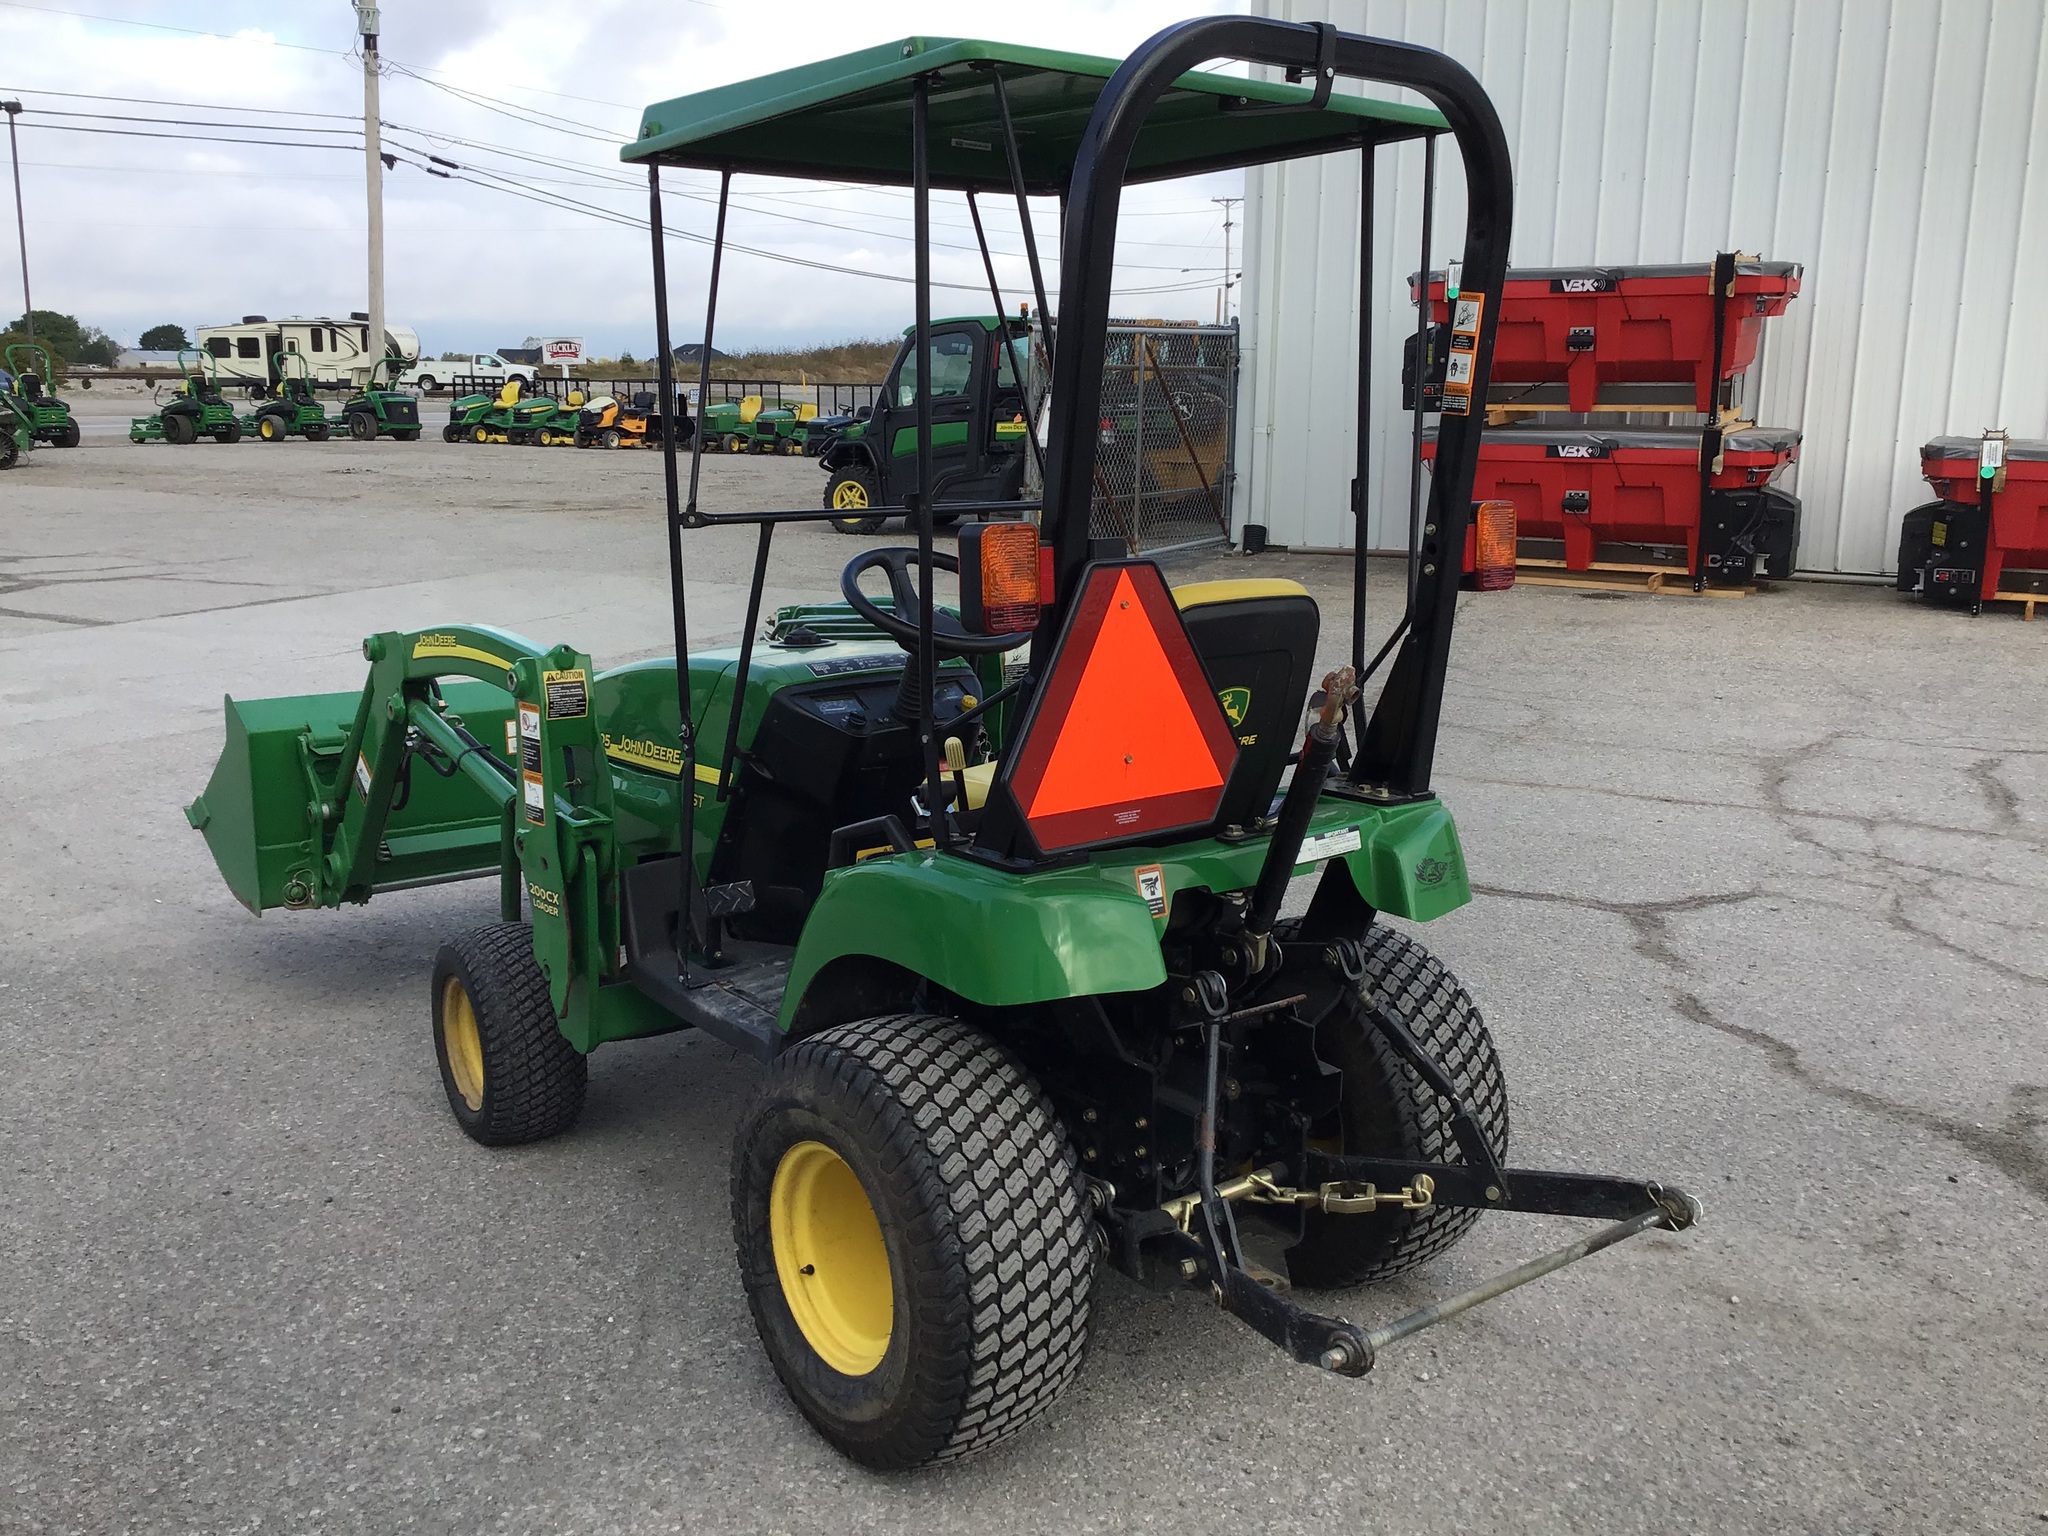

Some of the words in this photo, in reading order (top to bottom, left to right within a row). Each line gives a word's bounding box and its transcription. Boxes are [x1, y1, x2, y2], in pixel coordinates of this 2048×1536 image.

[547, 343, 581, 353] HECKLEY
[418, 634, 435, 646] JOHN
[434, 634, 456, 647] DEERE
[555, 671, 584, 681] CAUTION
[1239, 734, 1258, 746] RE
[618, 735, 645, 755] JOHN
[644, 740, 682, 763] DEERE
[529, 882, 560, 905] 200CX
[533, 898, 559, 916] LOADER
